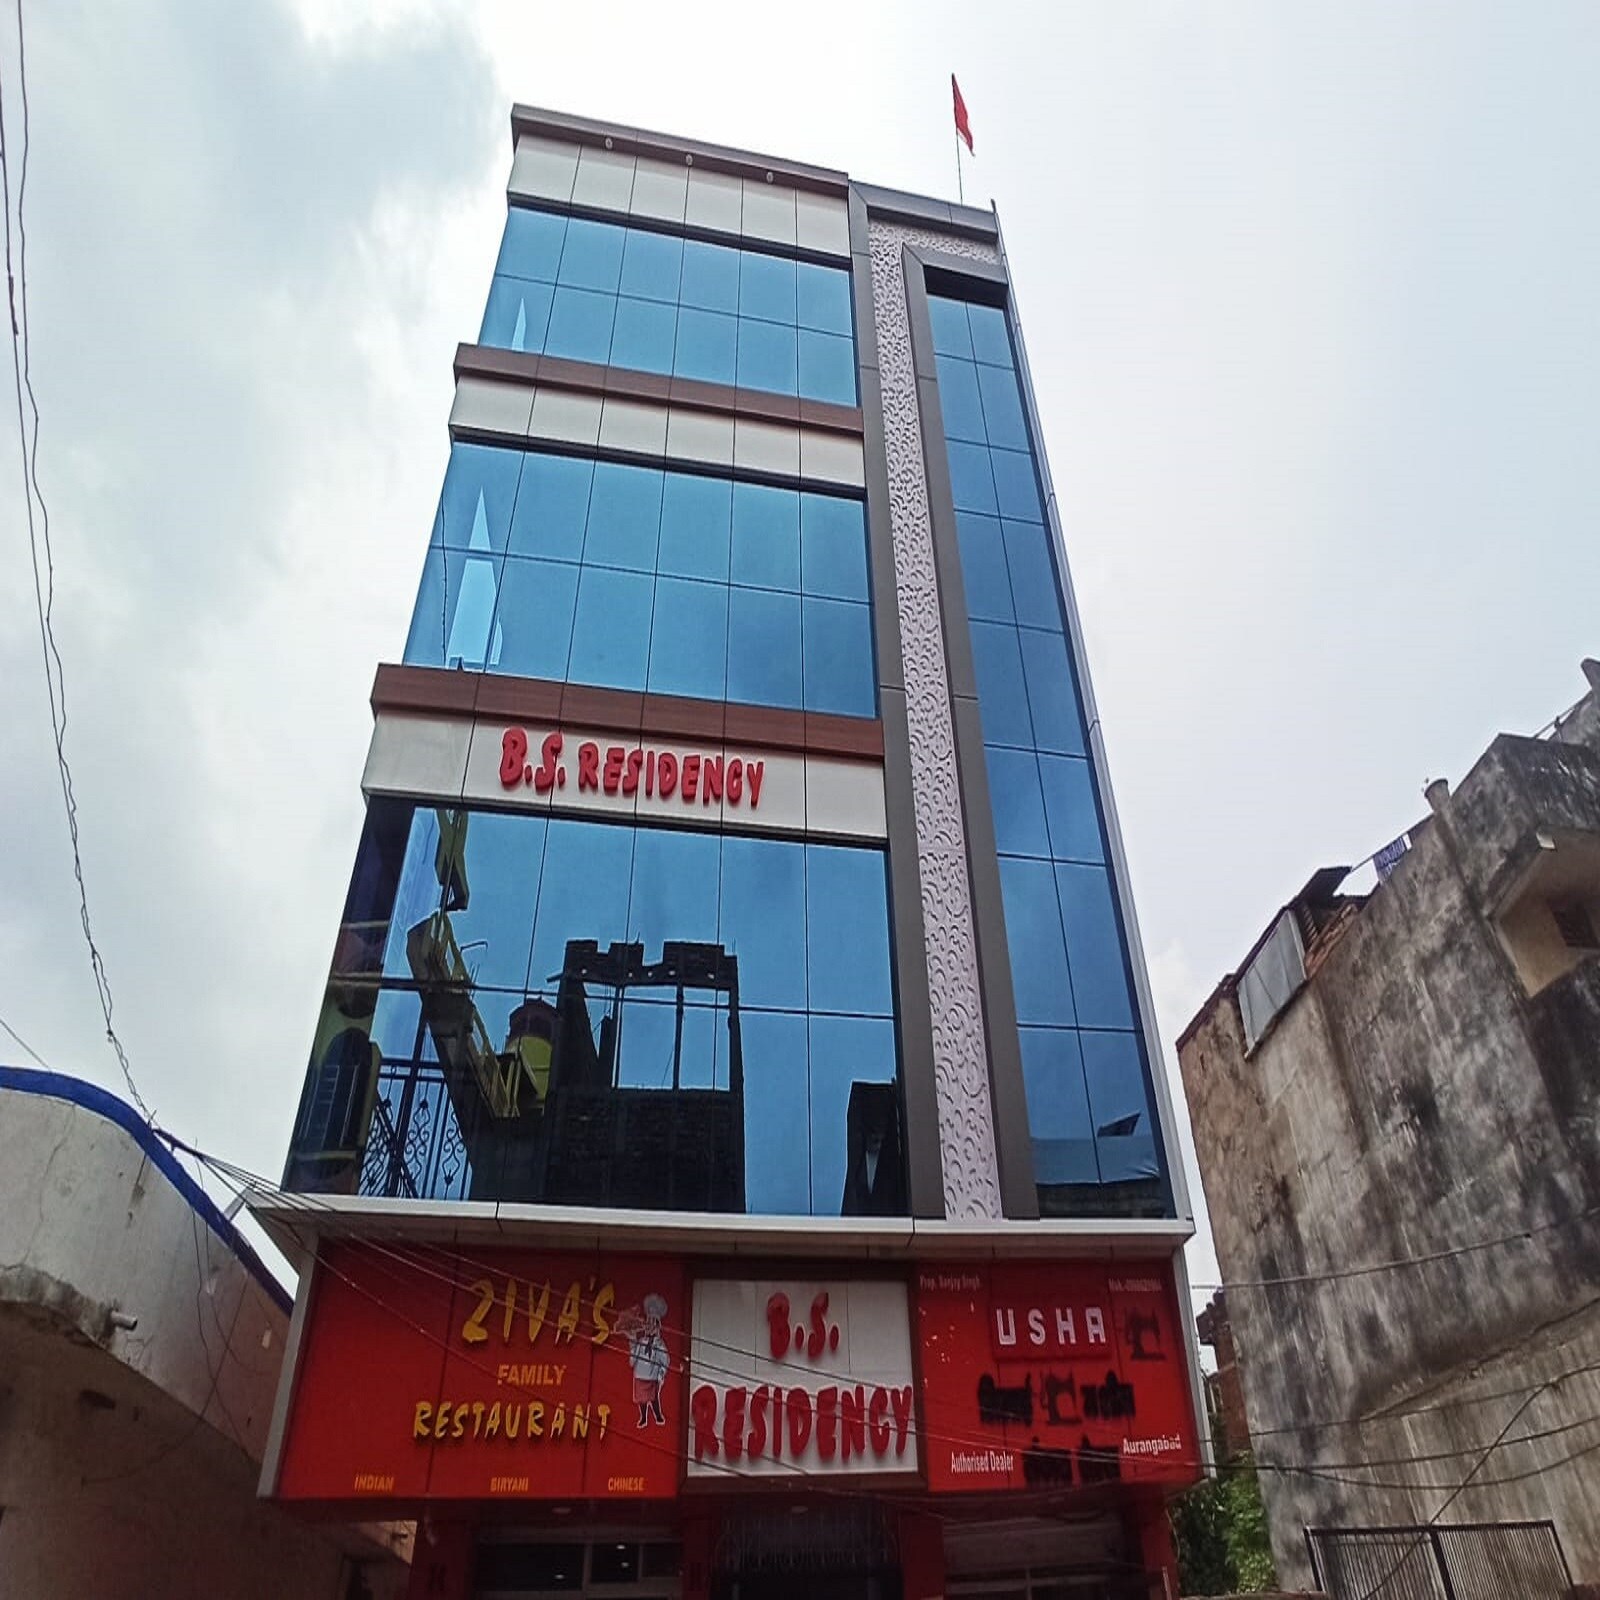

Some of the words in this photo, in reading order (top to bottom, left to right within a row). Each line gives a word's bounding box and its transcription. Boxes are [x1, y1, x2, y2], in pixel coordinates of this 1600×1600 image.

[500, 726, 566, 790] B.S.
[578, 741, 765, 807] RESIDENCY
[767, 1291, 840, 1360] B.S.
[996, 1306, 1106, 1345] USHA
[497, 1364, 567, 1386] FAMILY
[413, 1401, 611, 1440] RESTAURANT
[691, 1384, 912, 1462] RESIDENCY
[951, 1450, 989, 1474] Authorised
[990, 1450, 1014, 1472] Dealer
[354, 1474, 395, 1492] INDIAN
[490, 1476, 529, 1493] BIRYANI
